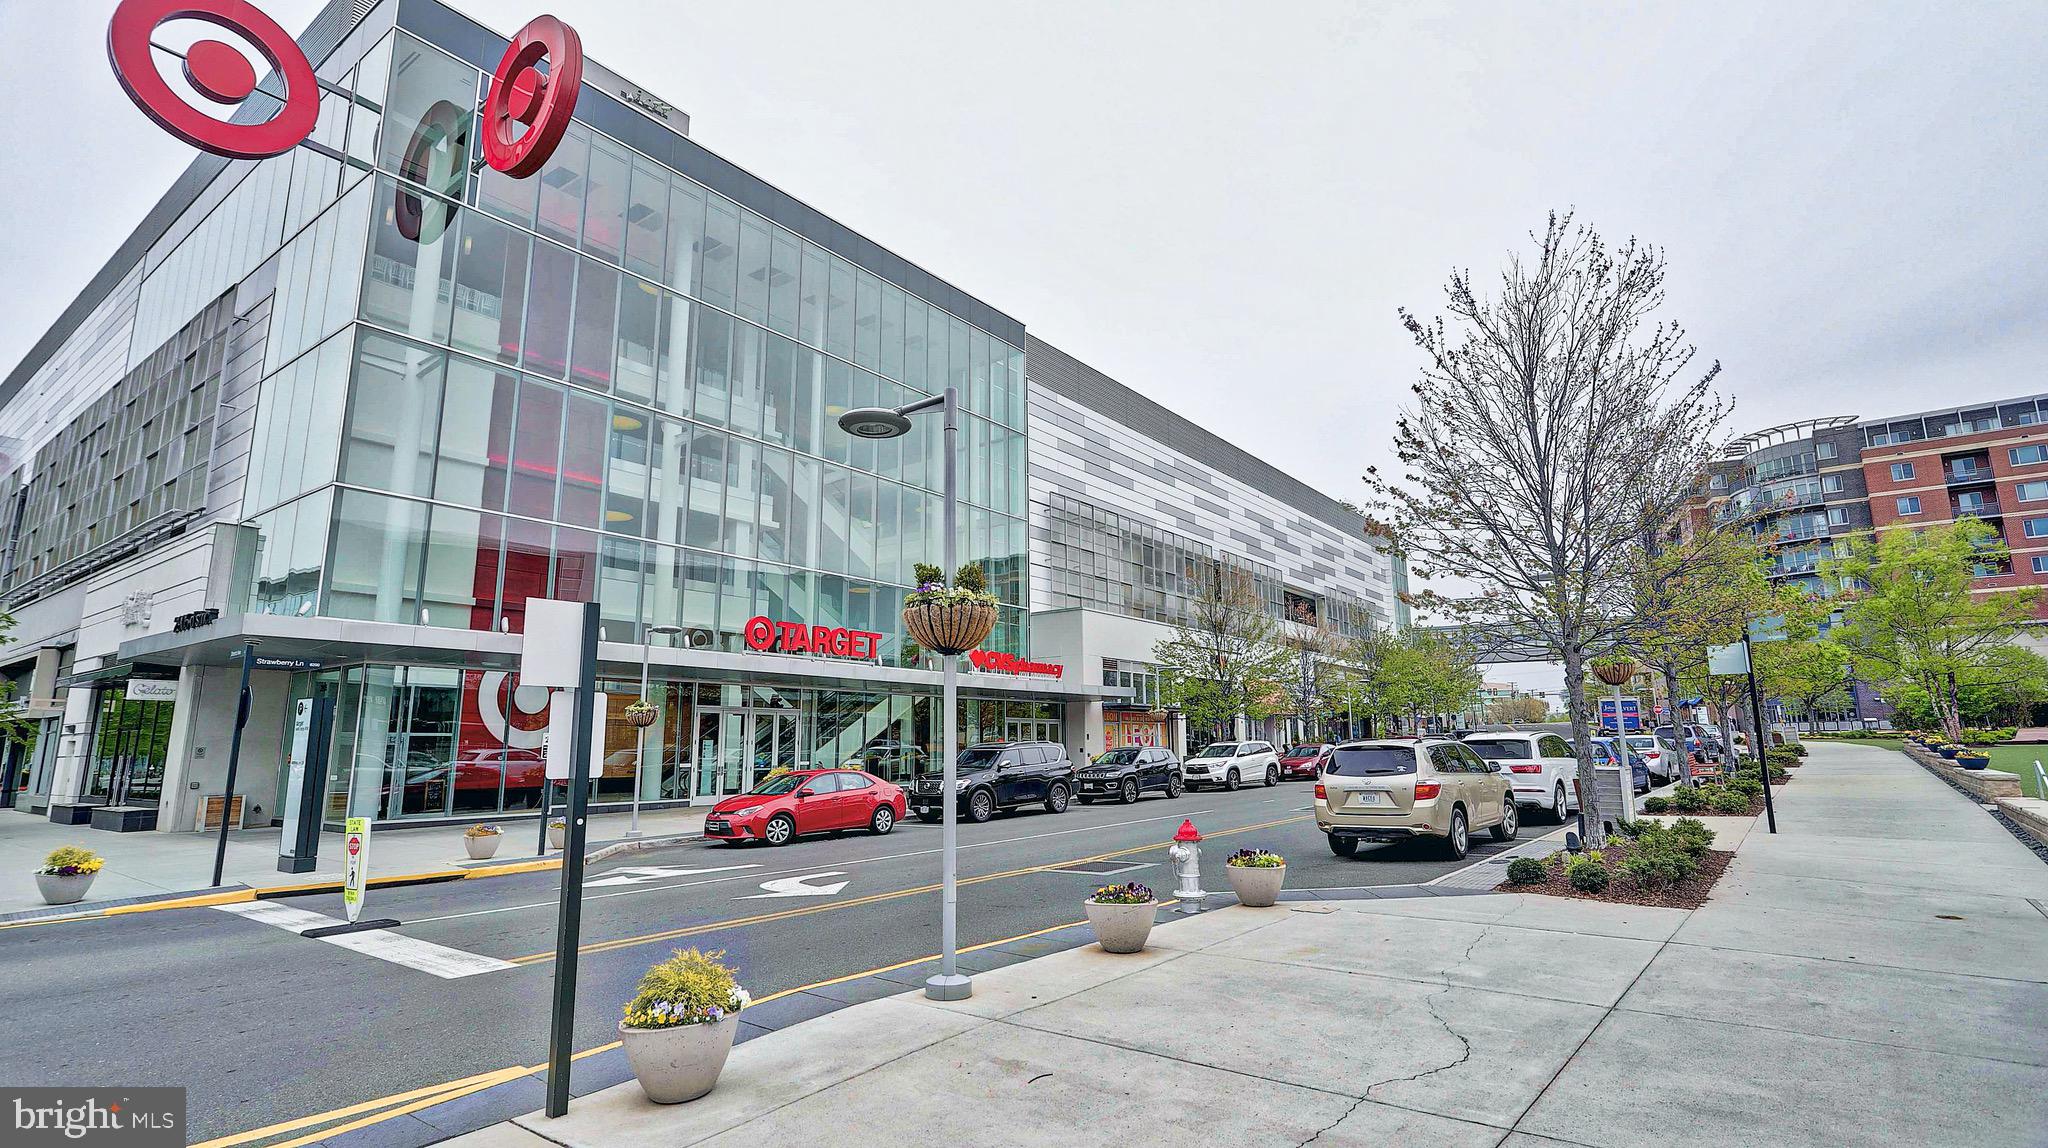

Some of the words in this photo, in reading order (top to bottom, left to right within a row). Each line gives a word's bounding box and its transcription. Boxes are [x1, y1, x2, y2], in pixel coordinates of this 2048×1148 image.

[776, 621, 882, 659] TARGET
[256, 657, 295, 667] Strawberry
[984, 650, 1015, 672] CVS
[1013, 657, 1063, 679] pharmacy
[133, 684, 175, 696] Gelato
